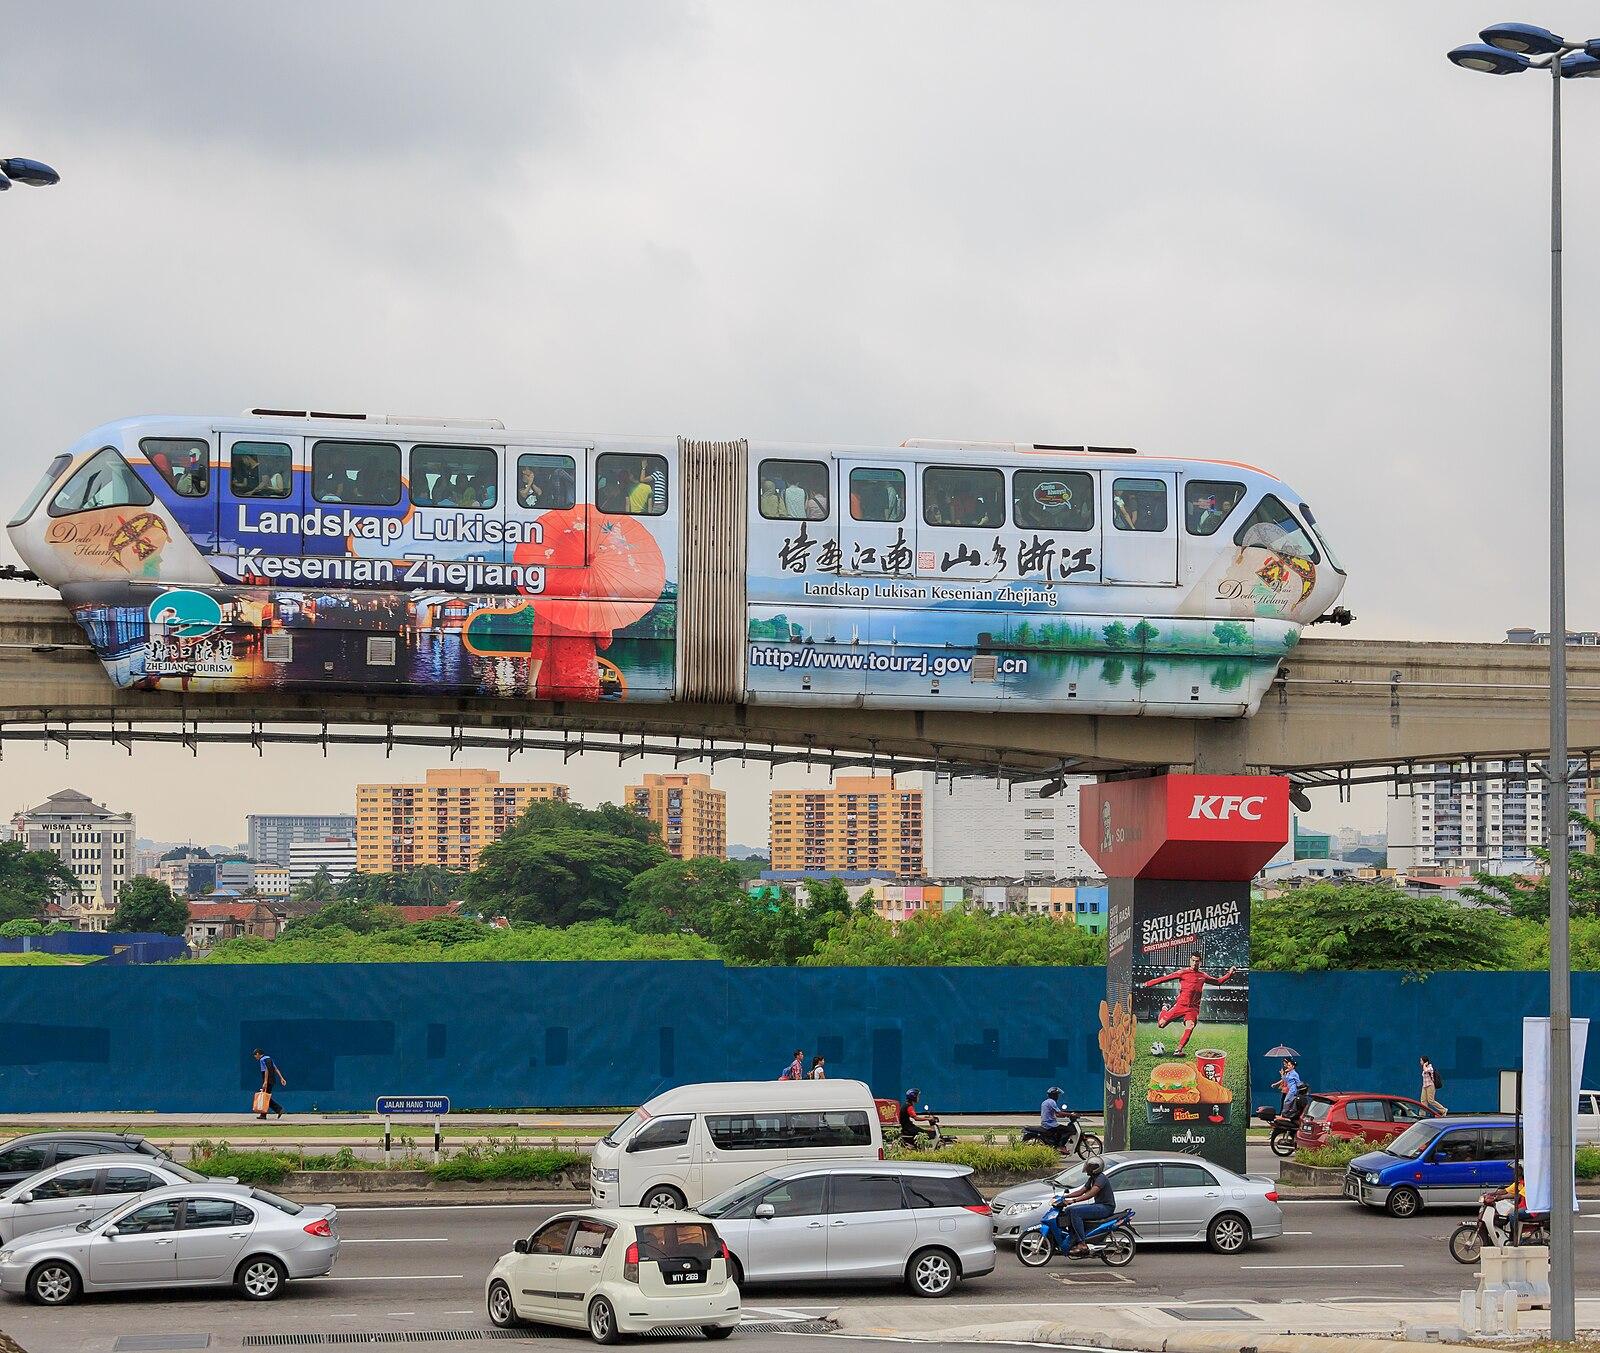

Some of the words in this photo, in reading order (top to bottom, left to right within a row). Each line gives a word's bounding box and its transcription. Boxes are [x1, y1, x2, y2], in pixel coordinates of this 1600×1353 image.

[238, 504, 404, 545] Landskap
[413, 511, 544, 544] Lukisan
[237, 547, 393, 581] Kesenian
[403, 554, 546, 593] Zhejiang
[805, 582, 870, 599] Landskap
[875, 584, 926, 599] Lukisan
[931, 586, 993, 601] Kesenian
[997, 588, 1058, 606] Zhejiang
[146, 662, 191, 671] ZHEJIANG
[1188, 795, 1265, 821] KFC
[1142, 914, 1173, 933] SATU
[1176, 908, 1201, 926] CITA
[1205, 900, 1238, 919] RASA
[1142, 927, 1174, 945] SATU
[1176, 912, 1241, 937] SEMANGAT
[1143, 941, 1170, 953] CRISTIANO
[1170, 936, 1194, 947] RONALDO
[384, 1101, 404, 1109] JALAN
[1172, 1131, 1206, 1144] RONALDO
